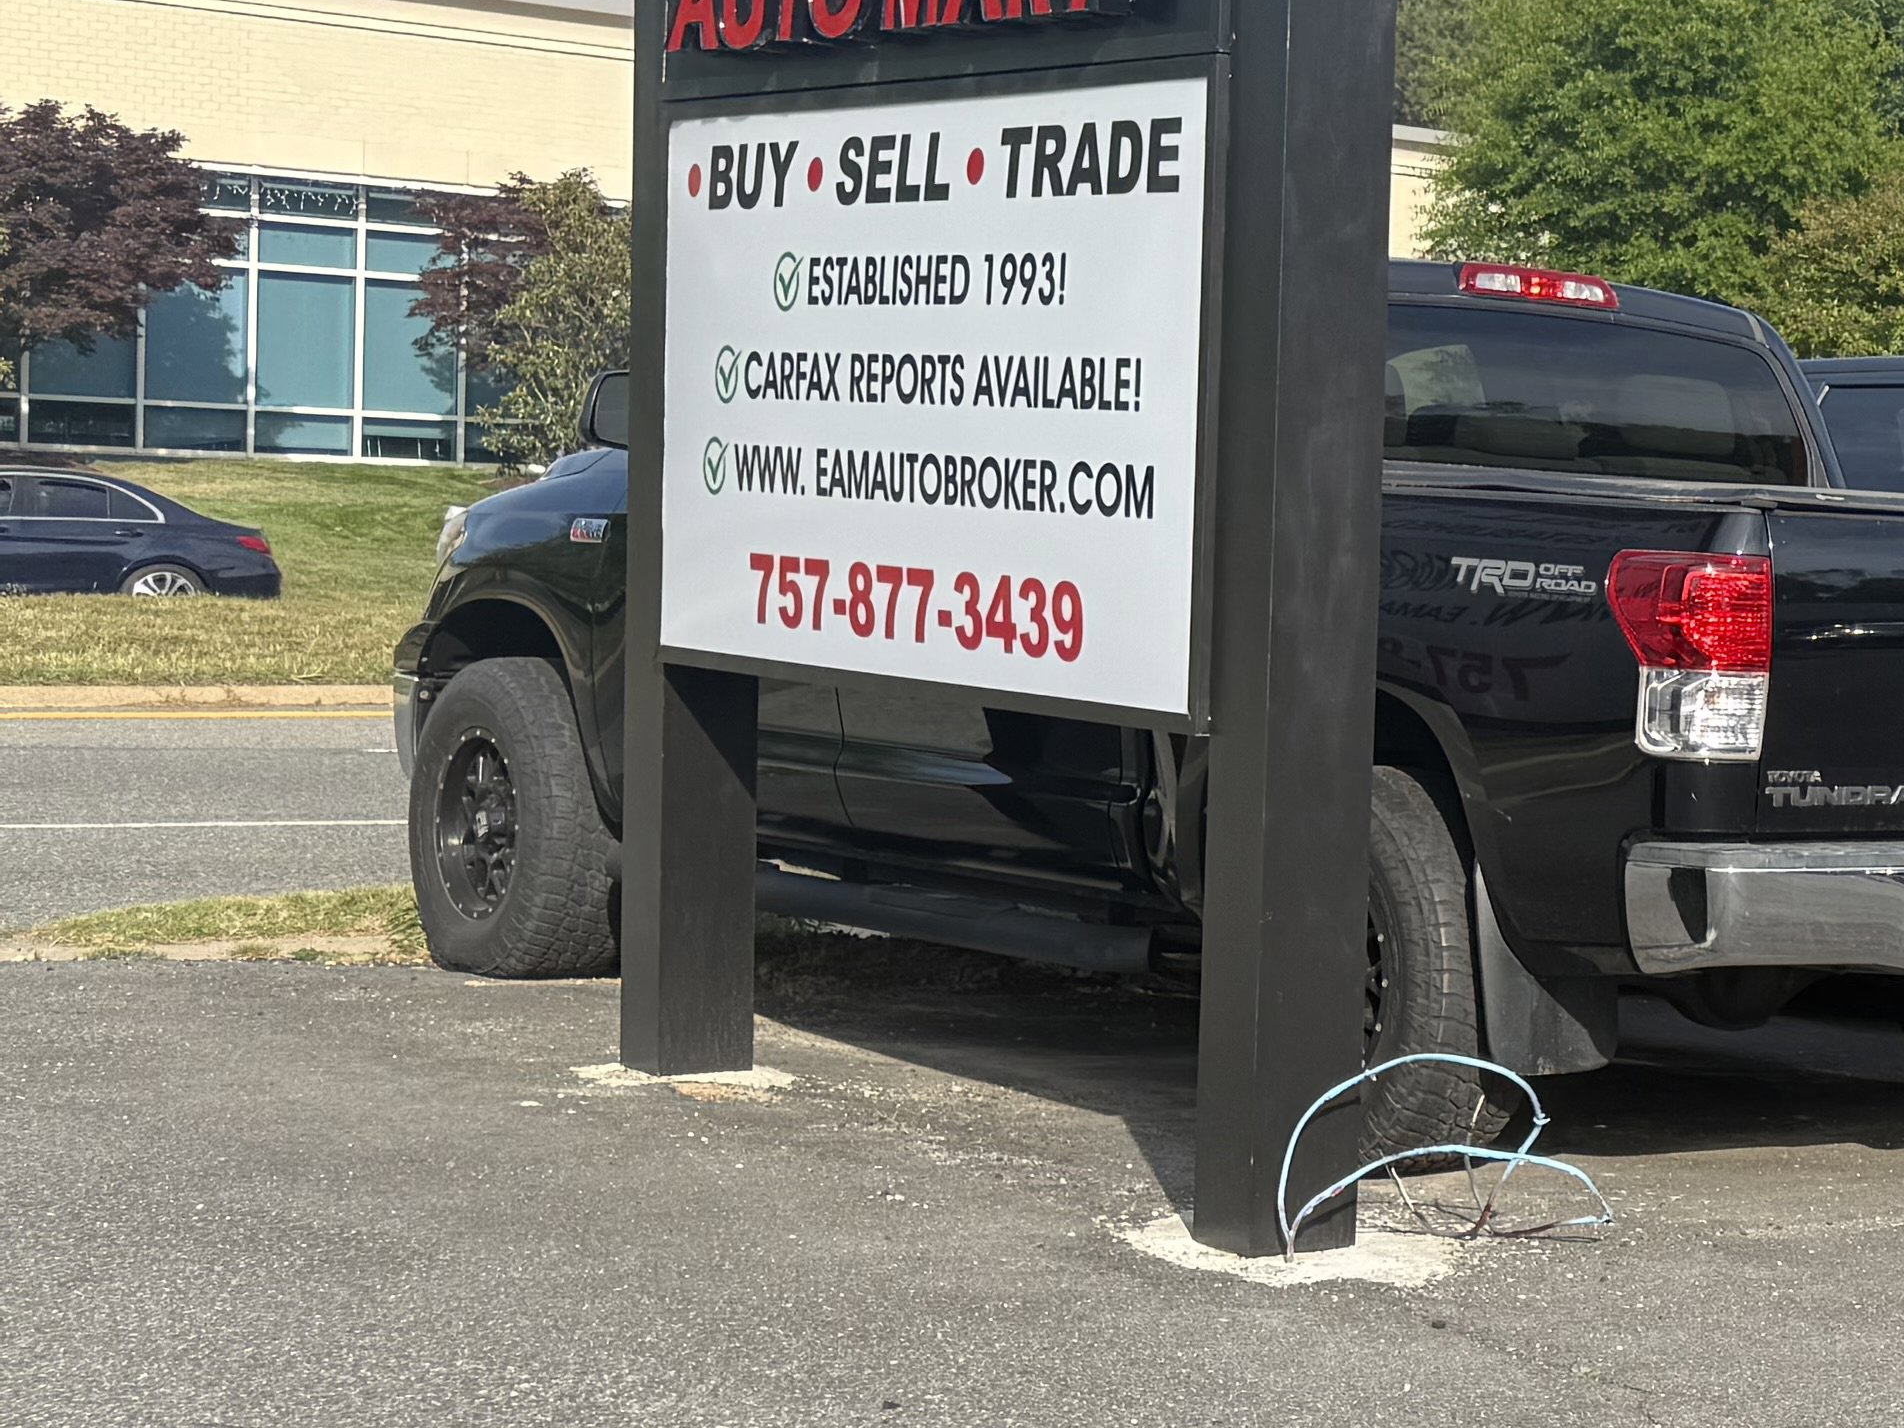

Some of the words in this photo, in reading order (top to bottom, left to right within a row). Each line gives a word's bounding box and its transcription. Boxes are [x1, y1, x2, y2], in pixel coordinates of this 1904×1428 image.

[708, 140, 799, 210] BUY
[836, 132, 950, 206] SELL
[1000, 117, 1182, 199] TRADE
[807, 254, 970, 306] ESTABLISHED
[984, 252, 1067, 306] 1993!
[744, 350, 841, 402] CARFAX
[850, 353, 965, 406] REPORTS
[973, 355, 1142, 412] AVAILABLE!
[734, 443, 806, 495] WWW.
[816, 448, 1155, 519] EAMAUTOBROKER.COM
[1450, 556, 1536, 597] TRD
[1535, 577, 1598, 596] ROAD
[1537, 562, 1586, 578] OFF
[749, 552, 1084, 662] 757-877-3439
[1767, 770, 1823, 783] TOYOTA
